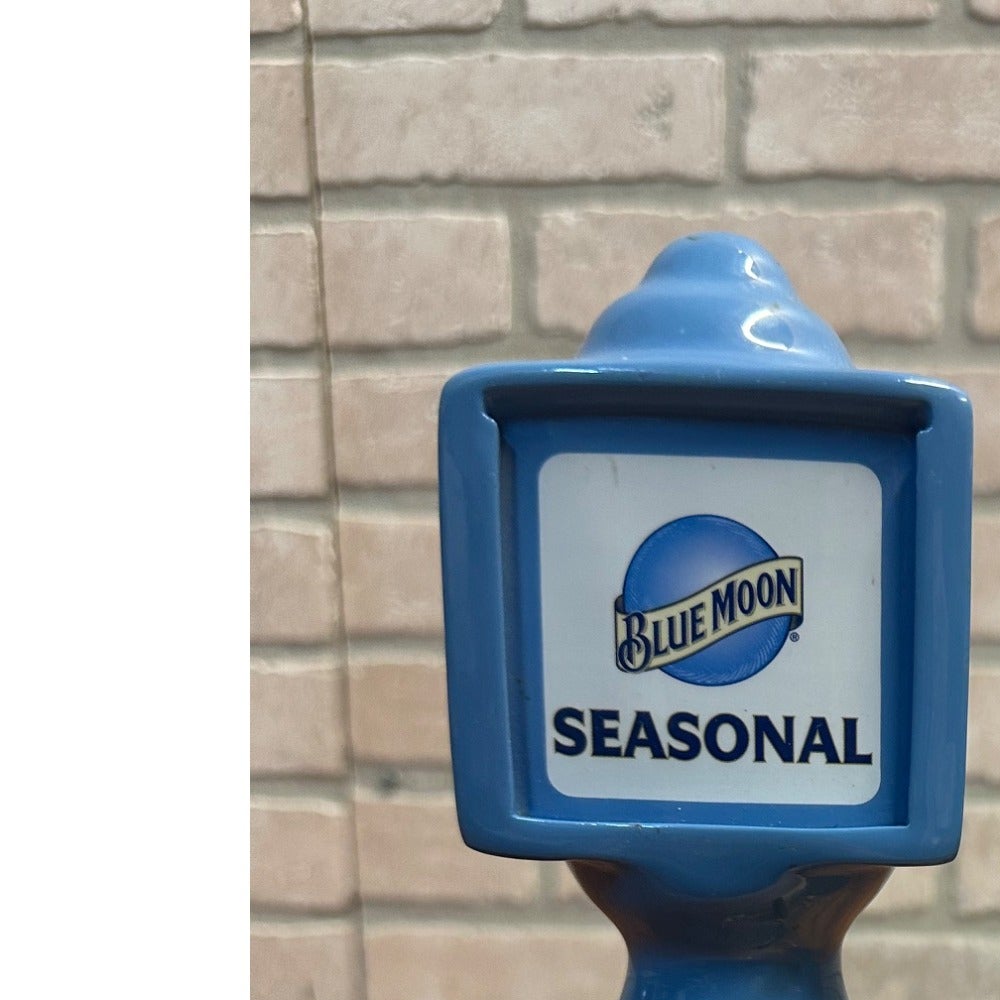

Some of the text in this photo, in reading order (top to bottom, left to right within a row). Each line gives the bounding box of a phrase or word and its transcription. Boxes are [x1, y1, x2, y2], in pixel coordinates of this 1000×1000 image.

[618, 567, 799, 671] BLUE MOON
[553, 706, 874, 766] SEASONAL
